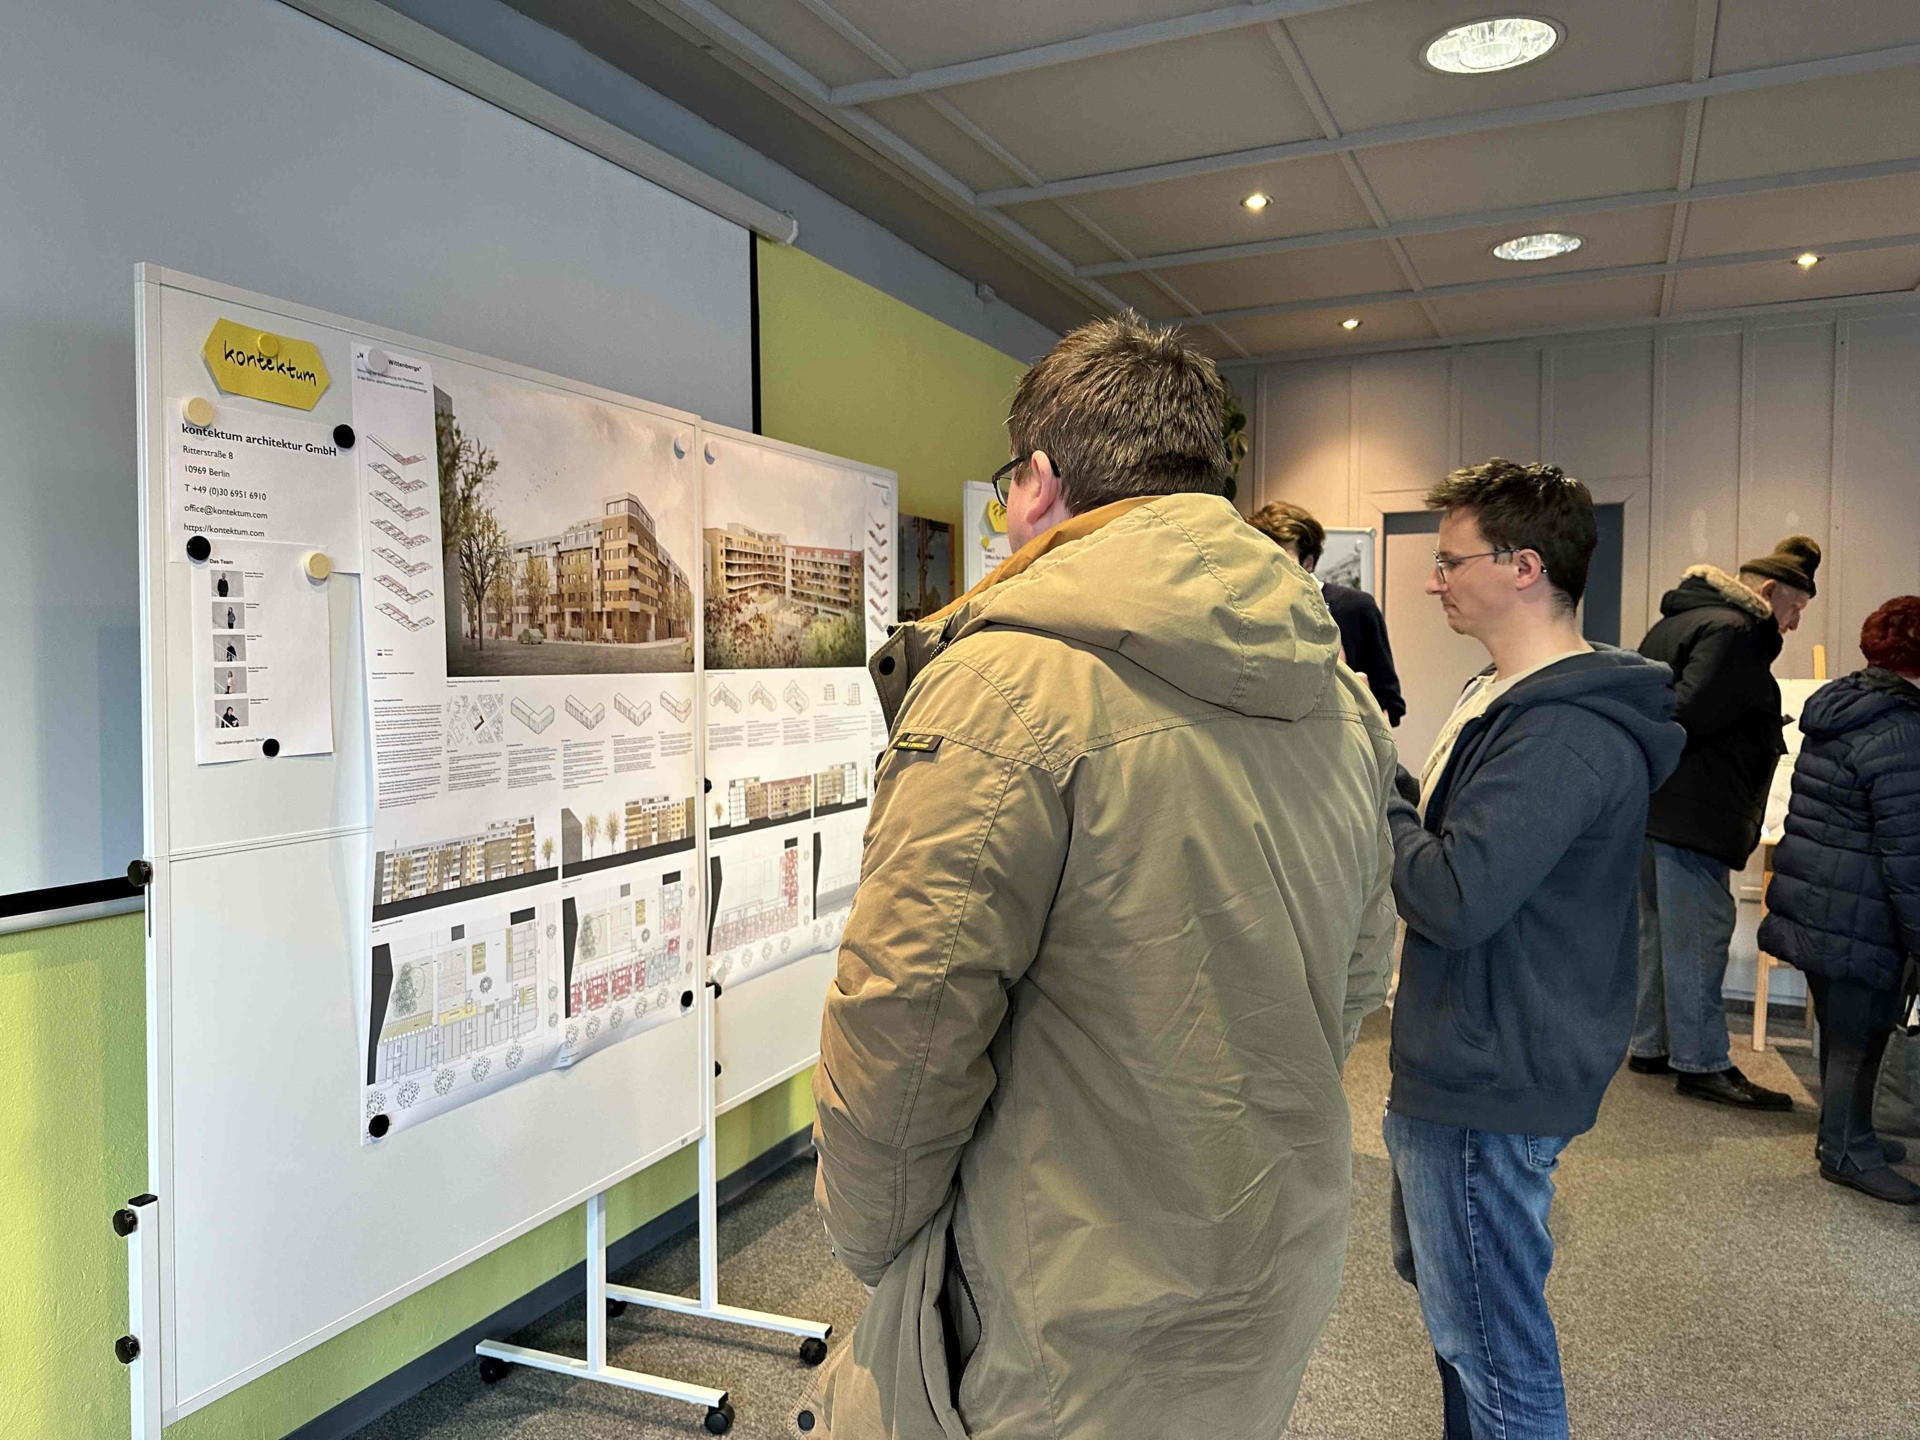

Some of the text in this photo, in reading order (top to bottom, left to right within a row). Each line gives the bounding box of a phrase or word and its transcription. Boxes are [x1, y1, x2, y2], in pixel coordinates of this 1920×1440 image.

[223, 340, 317, 387] kontektum
[181, 423, 337, 457] kontektum architektur GmbH
[182, 445, 234, 460] Ritterstraße 8
[184, 464, 230, 478] 10969 Berlin
[184, 483, 267, 501] T +49 (0)30 6951 6910
[184, 503, 268, 520] office@kontektum.com
[183, 522, 265, 538] https://kontektum.com
